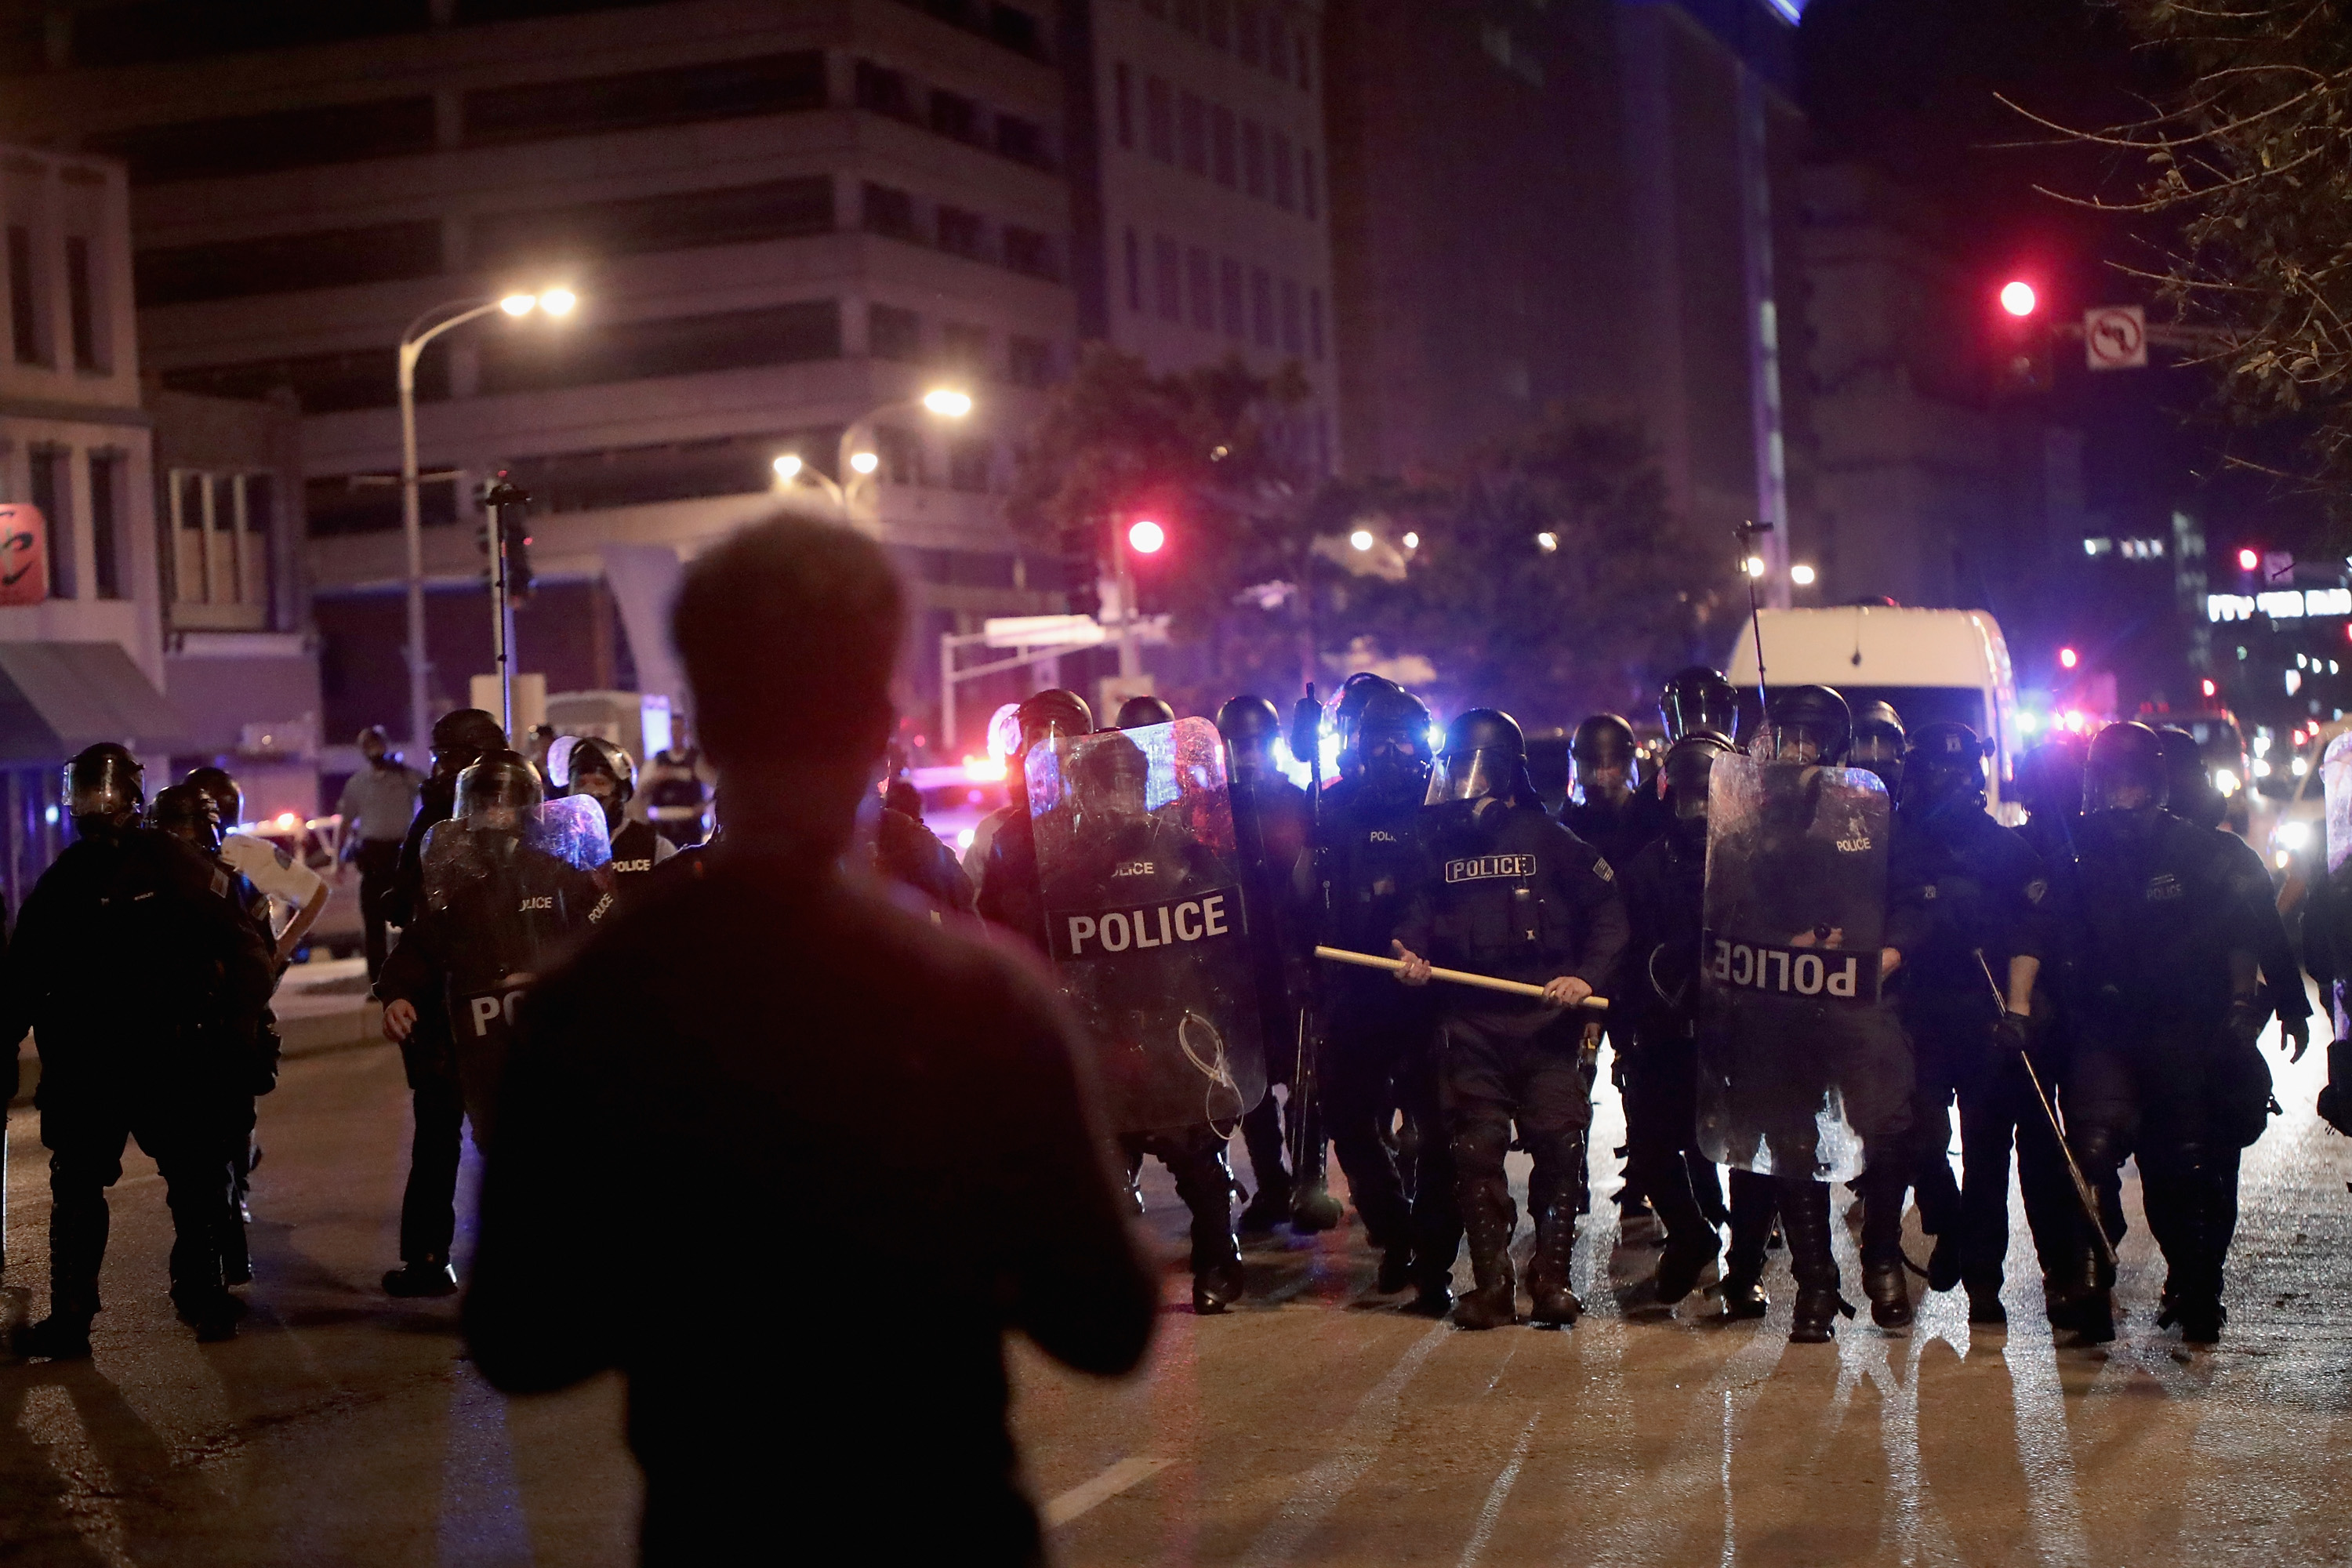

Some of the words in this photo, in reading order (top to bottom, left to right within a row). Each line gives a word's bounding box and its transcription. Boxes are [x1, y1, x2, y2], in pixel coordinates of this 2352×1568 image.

[1836, 837, 1871, 852] POLICE
[1453, 857, 1527, 879] POLICE
[588, 892, 614, 924] POLICE
[1068, 895, 1229, 954] POLICE
[1715, 939, 1857, 997] POLICE
